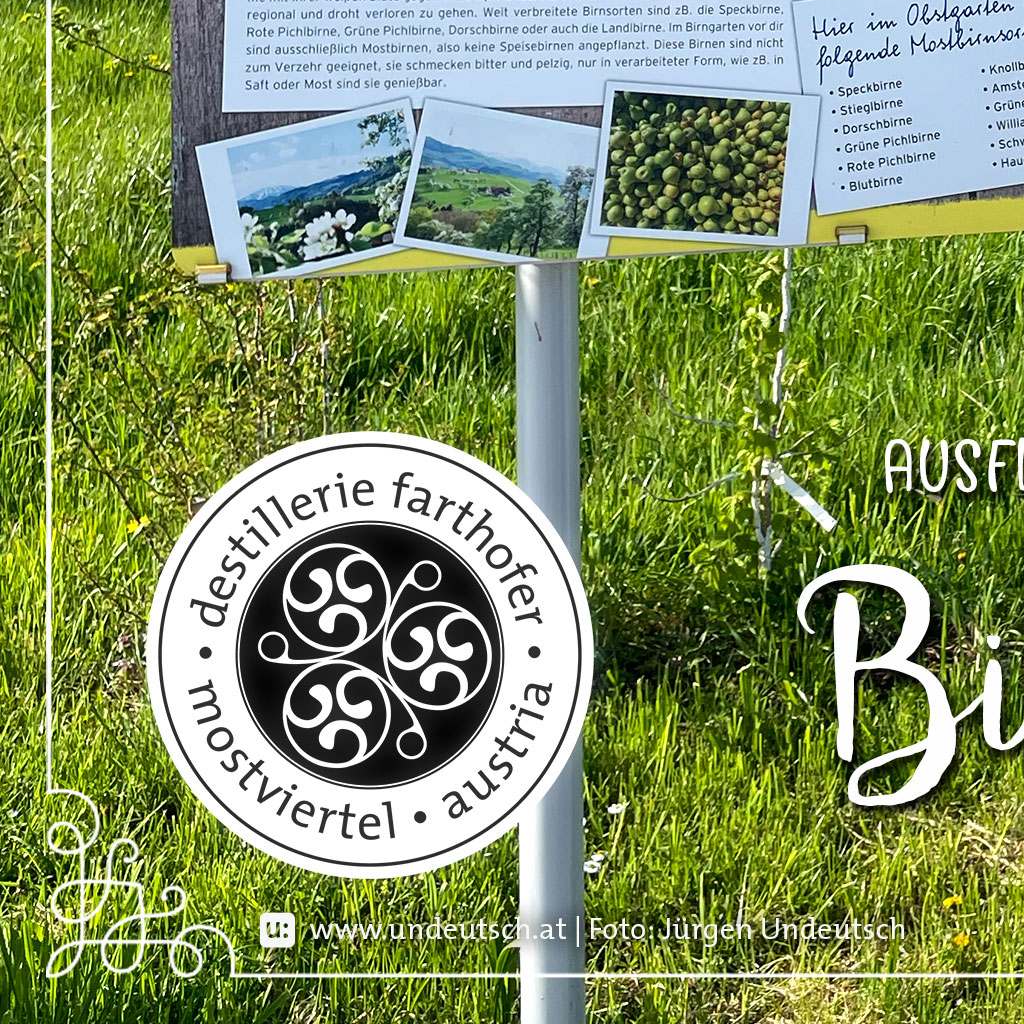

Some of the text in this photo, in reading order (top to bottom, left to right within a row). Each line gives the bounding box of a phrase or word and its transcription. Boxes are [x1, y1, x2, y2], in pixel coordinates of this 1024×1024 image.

[812, 15, 854, 41] Hier
[866, 12, 898, 31] im
[815, 37, 901, 85] folgende
[245, 77, 446, 91] Saft oder Most sind sie genießbar.
[838, 80, 903, 98] Speckbirne
[840, 99, 904, 116] Stieglbirne
[842, 116, 913, 135] Dorschbirne
[844, 132, 941, 154] Grüne Pichlbirne
[847, 151, 936, 173] Rote Pichlbirne
[849, 176, 903, 192] Blutbirne
